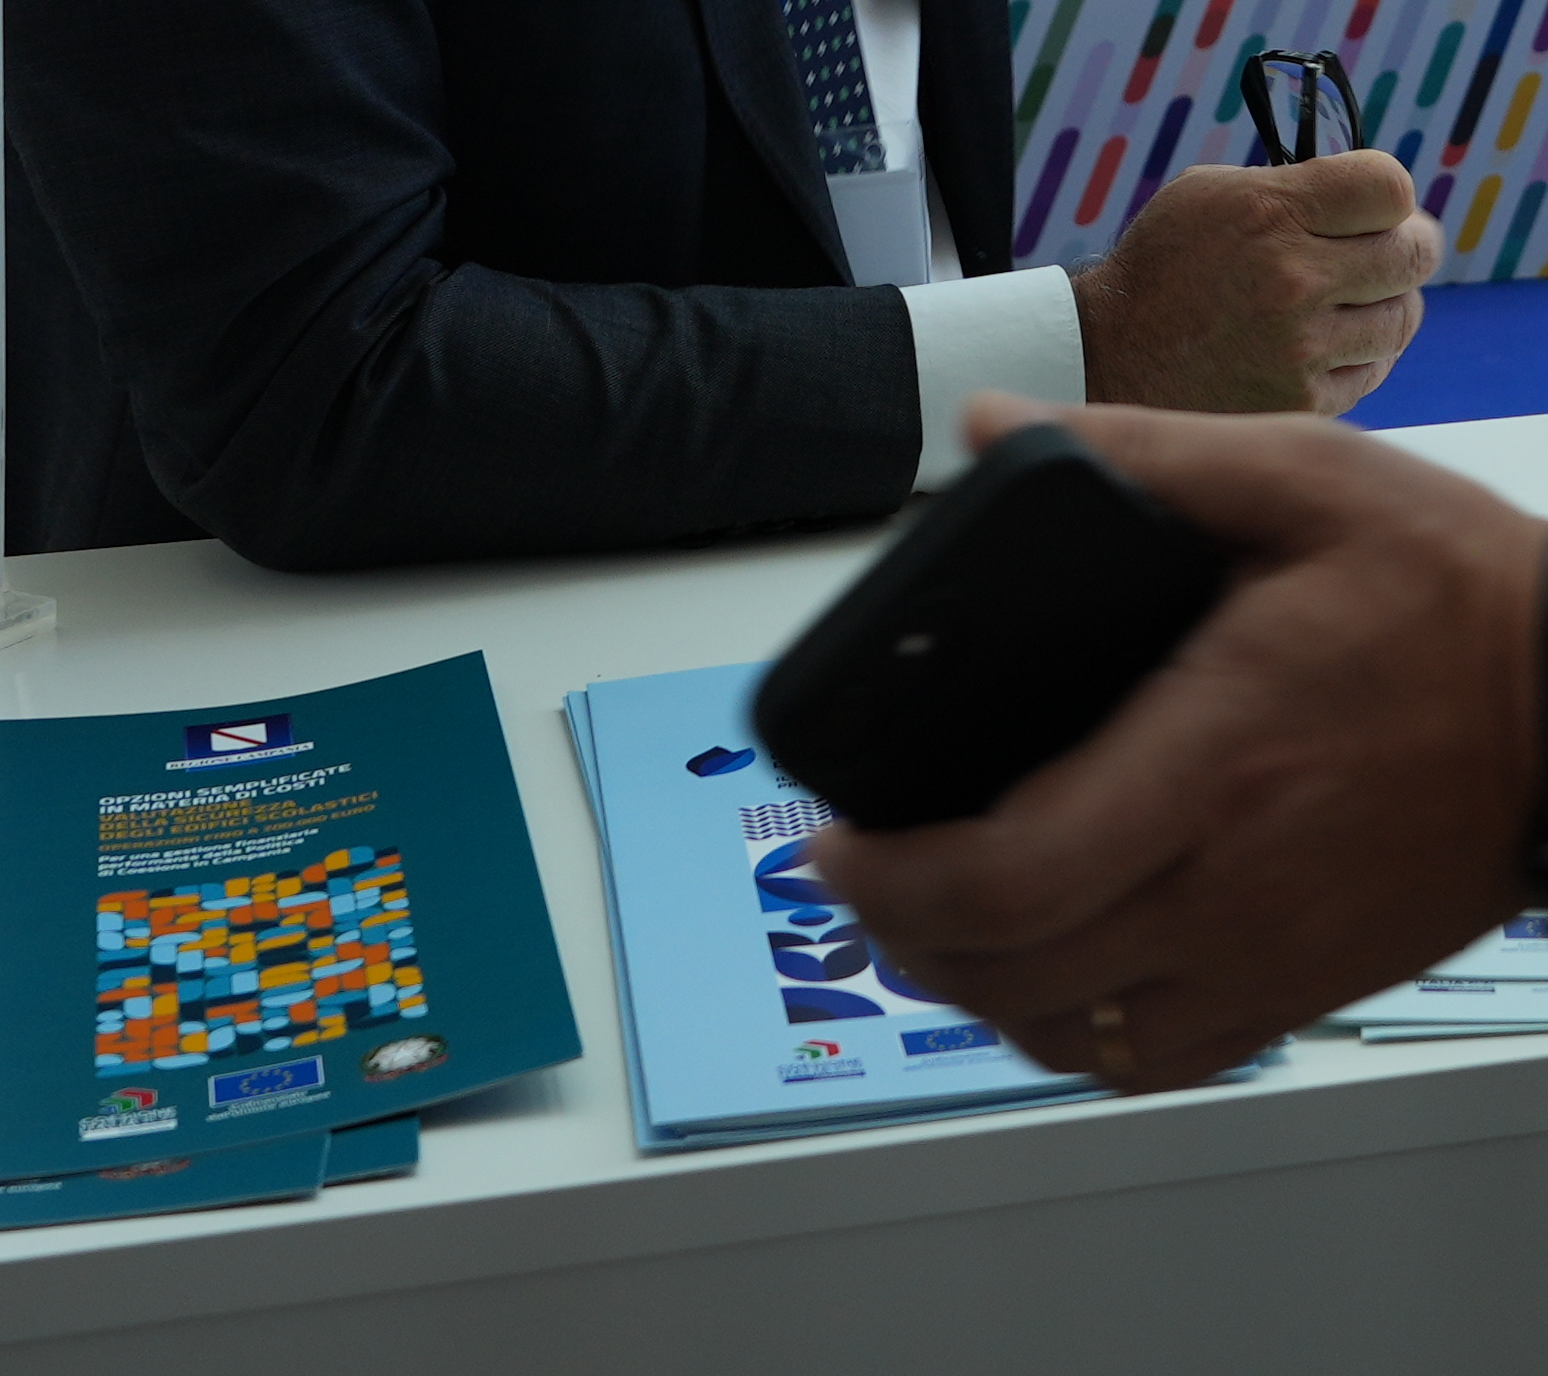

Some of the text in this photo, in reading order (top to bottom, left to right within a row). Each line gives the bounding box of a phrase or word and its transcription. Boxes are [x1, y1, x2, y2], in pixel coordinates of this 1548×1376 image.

[98, 761, 354, 807] OPZIONI SEMPLIFICATE
[98, 777, 327, 815] IN MATERIA DI COSTI
[99, 798, 252, 823] VALUTAZIONE
[99, 800, 297, 831] DELLA SICUREZZA
[99, 827, 165, 841] DEGLI
[254, 792, 379, 823] SCOLASTICI
[97, 827, 320, 864] Per una gestione finanziaria
[97, 847, 292, 878] di Coesione in Campania
